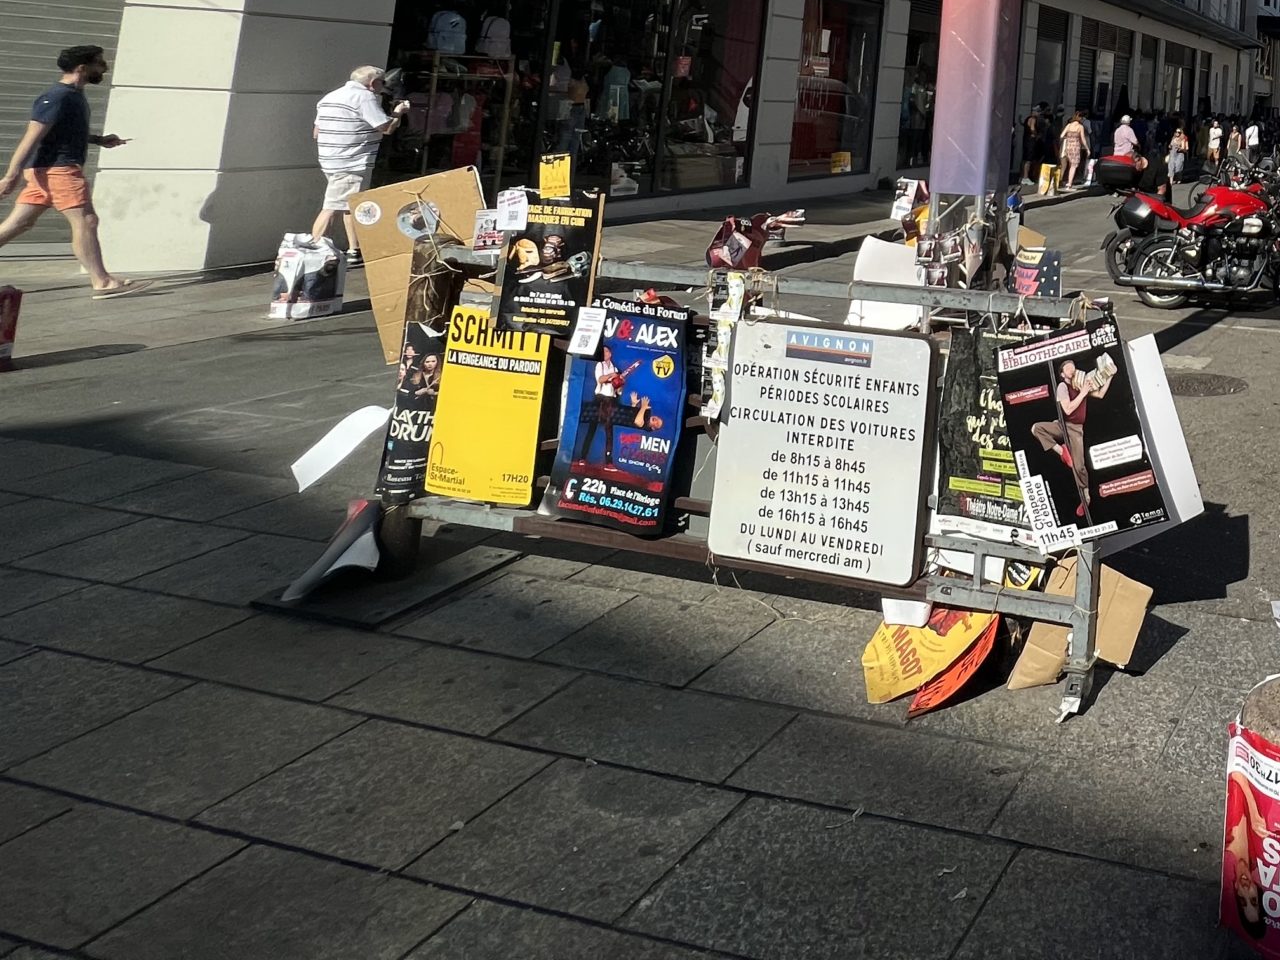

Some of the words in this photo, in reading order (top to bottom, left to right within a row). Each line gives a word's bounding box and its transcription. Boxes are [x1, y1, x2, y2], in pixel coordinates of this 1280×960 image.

[602, 298, 641, 314] Comédie
[643, 303, 656, 316] du
[657, 306, 687, 320] Forum
[635, 323, 678, 349] ALEX
[790, 333, 870, 352] AVIGNON
[448, 350, 455, 363] LA
[457, 352, 497, 368] VENGEANCE
[498, 356, 508, 371] DU
[509, 358, 540, 374] PARDON
[1001, 351, 1014, 361] LE
[656, 365, 670, 376] TV
[734, 362, 800, 382] OPÉRATION
[804, 368, 861, 389] SÉCURITÉ
[866, 378, 920, 397] ENFANTS
[760, 385, 819, 405] PÉRIODES
[824, 394, 889, 414] SCOLAIRES
[730, 406, 815, 427] CIRCULATION
[820, 418, 845, 431] DES
[851, 421, 916, 441] VOITURES
[640, 435, 671, 455] MEN
[786, 431, 855, 451] INTERDITE
[771, 450, 786, 462] de
[790, 452, 820, 467] 8h15
[824, 456, 831, 469] à
[835, 457, 866, 474] 8h45
[430, 471, 465, 486] St-Martial
[501, 473, 529, 484] 17H20
[581, 478, 607, 495] 22h
[610, 486, 625, 498] Place
[626, 489, 633, 499] de
[763, 468, 778, 480] de
[782, 471, 818, 486] 11h15
[822, 475, 829, 488] à
[834, 476, 871, 494] 11h45
[578, 492, 597, 505] Rés.
[760, 487, 775, 499] de
[780, 489, 817, 505] 13h15
[820, 494, 828, 507] à
[832, 497, 870, 514] 13h45
[1024, 480, 1044, 531] Chapeau
[758, 506, 773, 518] de
[778, 508, 815, 525] 16h15
[818, 513, 826, 527] à
[830, 516, 868, 533] 16h45
[740, 523, 755, 535] DU
[760, 525, 796, 542] LUNDI
[801, 532, 816, 544] AU
[821, 535, 883, 556] VENDREDI
[1039, 526, 1075, 545] 11h45
[755, 542, 783, 556] sauf
[785, 547, 840, 566] mercredi
[843, 557, 862, 569] am
